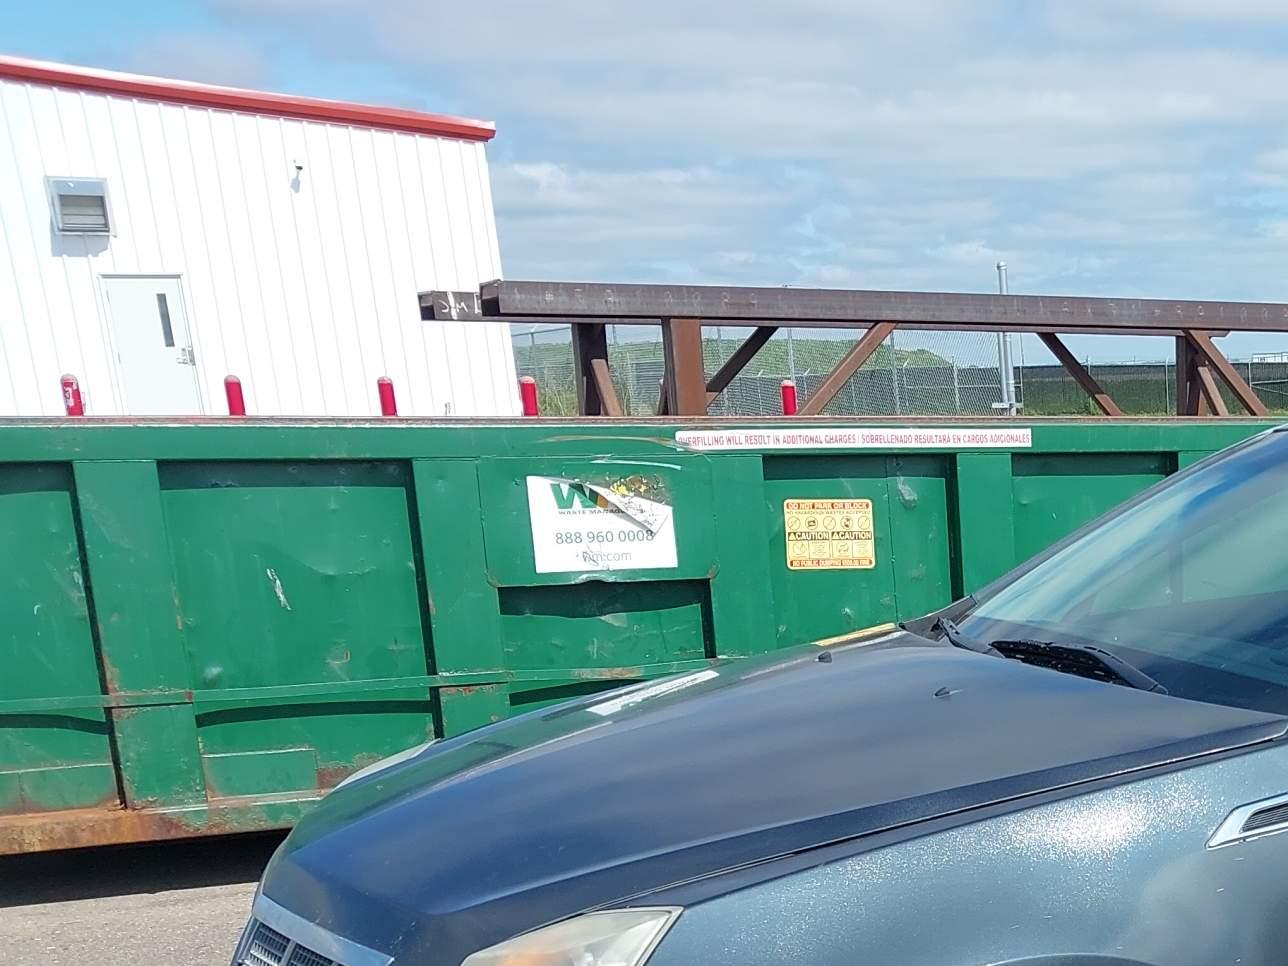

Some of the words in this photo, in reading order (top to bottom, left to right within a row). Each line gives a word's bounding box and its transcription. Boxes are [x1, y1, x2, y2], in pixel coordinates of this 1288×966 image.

[726, 435, 743, 446] WILL
[744, 434, 771, 445] RESULT
[773, 434, 780, 445] IN
[782, 434, 823, 445] ADDITIONAL
[824, 434, 857, 444] CHARGES
[861, 433, 913, 444] SOBRELLENADO
[952, 433, 961, 443] EN
[962, 433, 989, 443] CARGOS
[989, 433, 1030, 443] ADICIONALES
[555, 531, 583, 545] 888
[586, 531, 614, 543] 960
[618, 529, 654, 542] 0008
[795, 532, 829, 540] CAUTION
[839, 531, 872, 540] CAUTION
